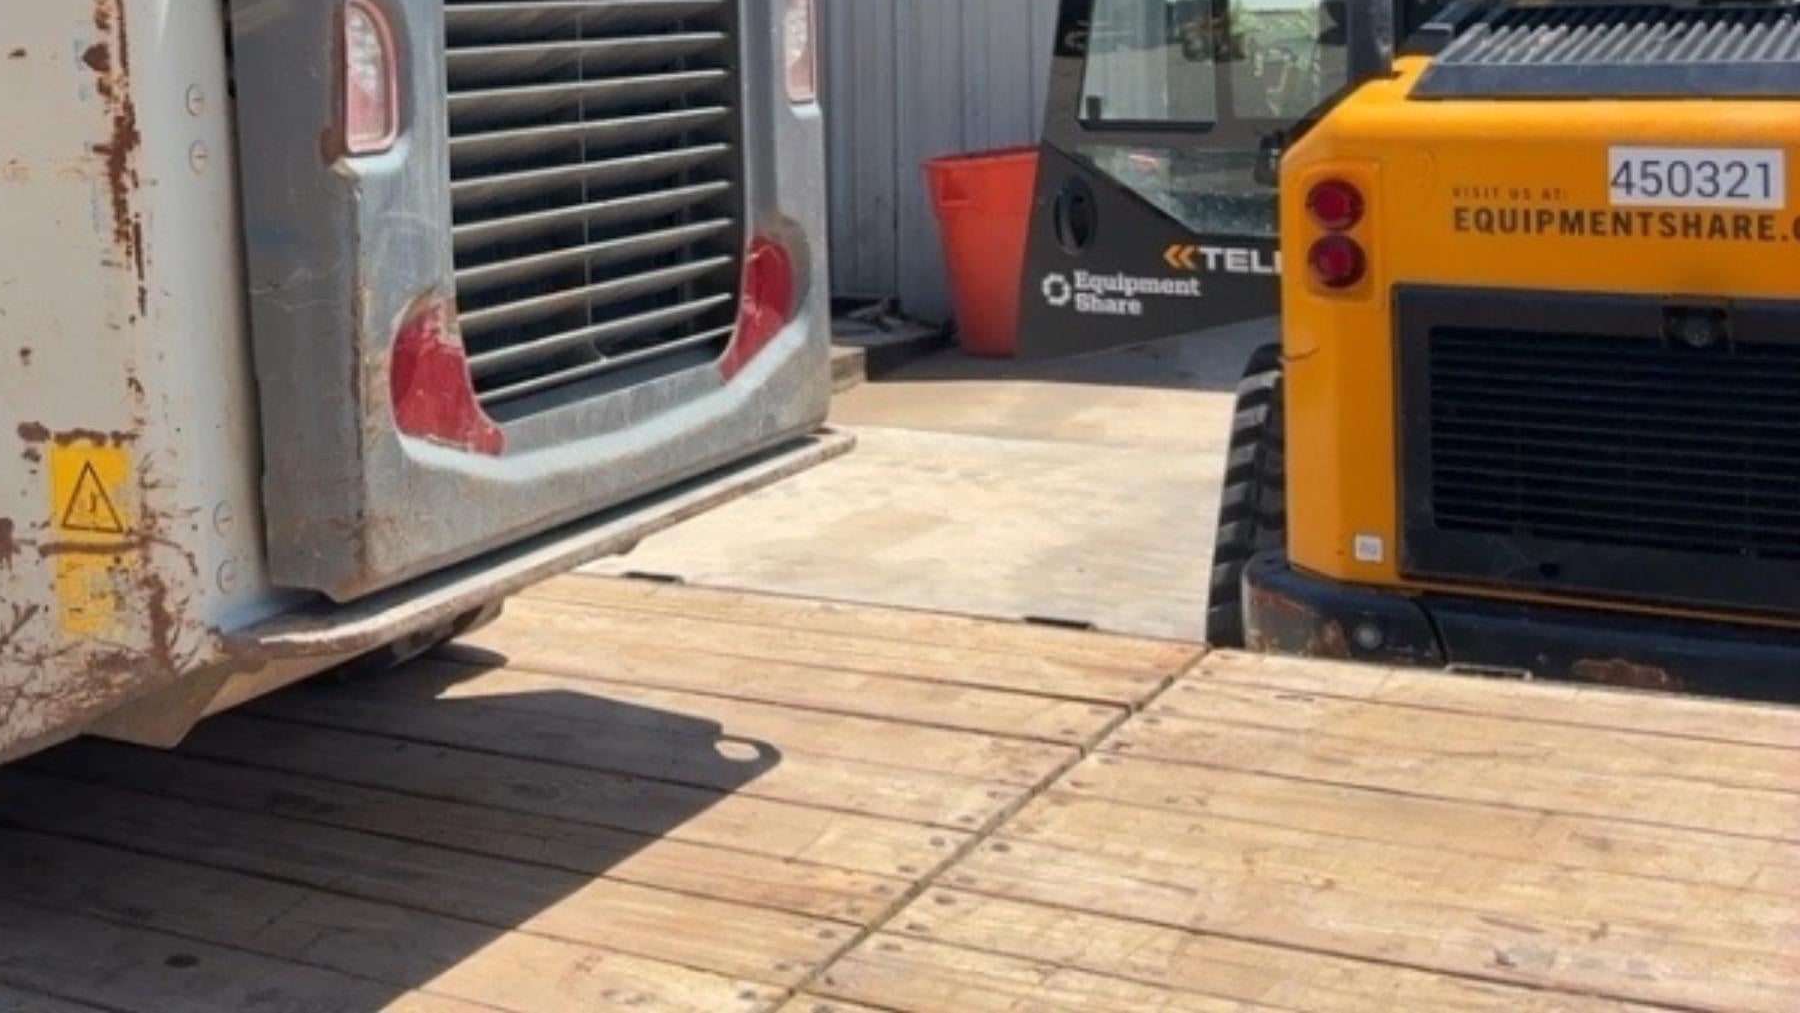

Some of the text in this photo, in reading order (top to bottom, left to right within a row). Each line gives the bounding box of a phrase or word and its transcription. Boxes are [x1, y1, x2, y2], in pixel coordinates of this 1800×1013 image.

[1611, 160, 1771, 198] 450321
[1199, 246, 1281, 274] TEL
[1074, 270, 1202, 297] Equipment
[1076, 292, 1142, 315] Share
